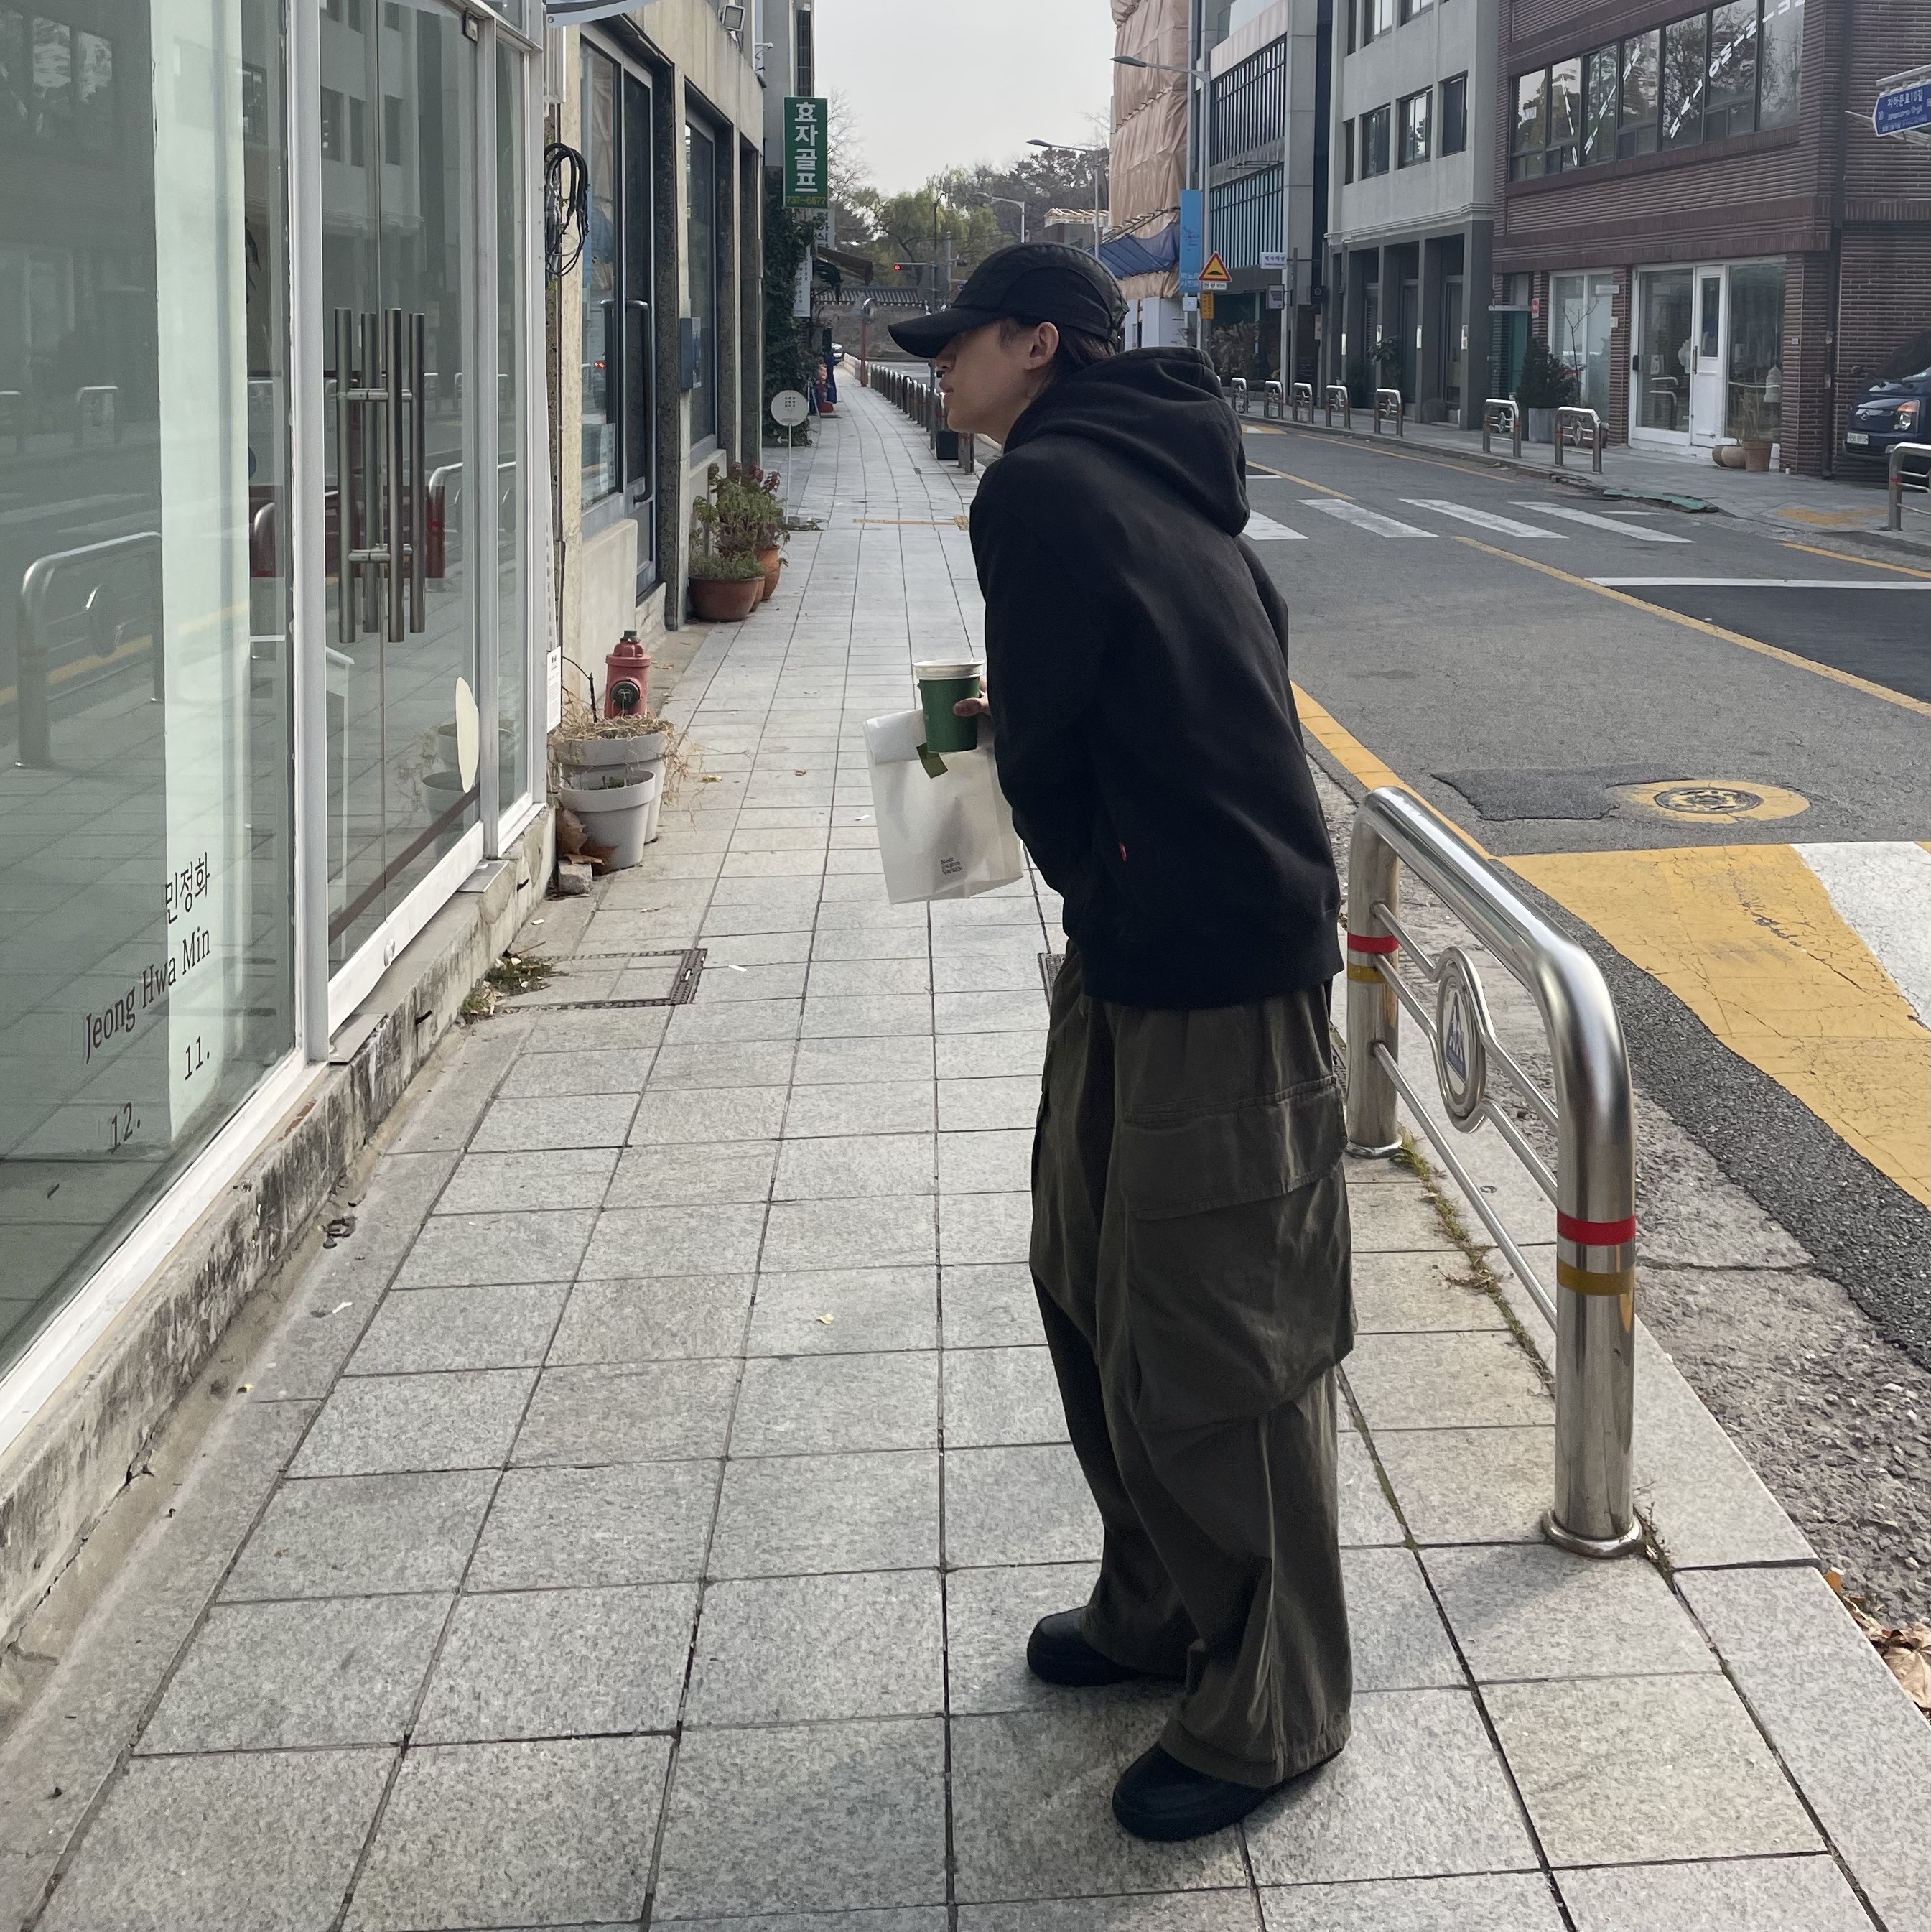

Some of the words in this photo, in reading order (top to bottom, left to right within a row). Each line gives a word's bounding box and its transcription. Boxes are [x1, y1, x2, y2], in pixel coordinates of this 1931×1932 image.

[1670, 0, 1805, 139] HALOMINIU
[794, 101, 818, 192] 효자골프
[165, 851, 210, 924] 민정화
[85, 985, 136, 1064] Jeong
[141, 956, 177, 1010] Hwa
[182, 926, 210, 975] Min
[185, 1036, 210, 1081] 11.
[109, 1102, 141, 1153] 12.
